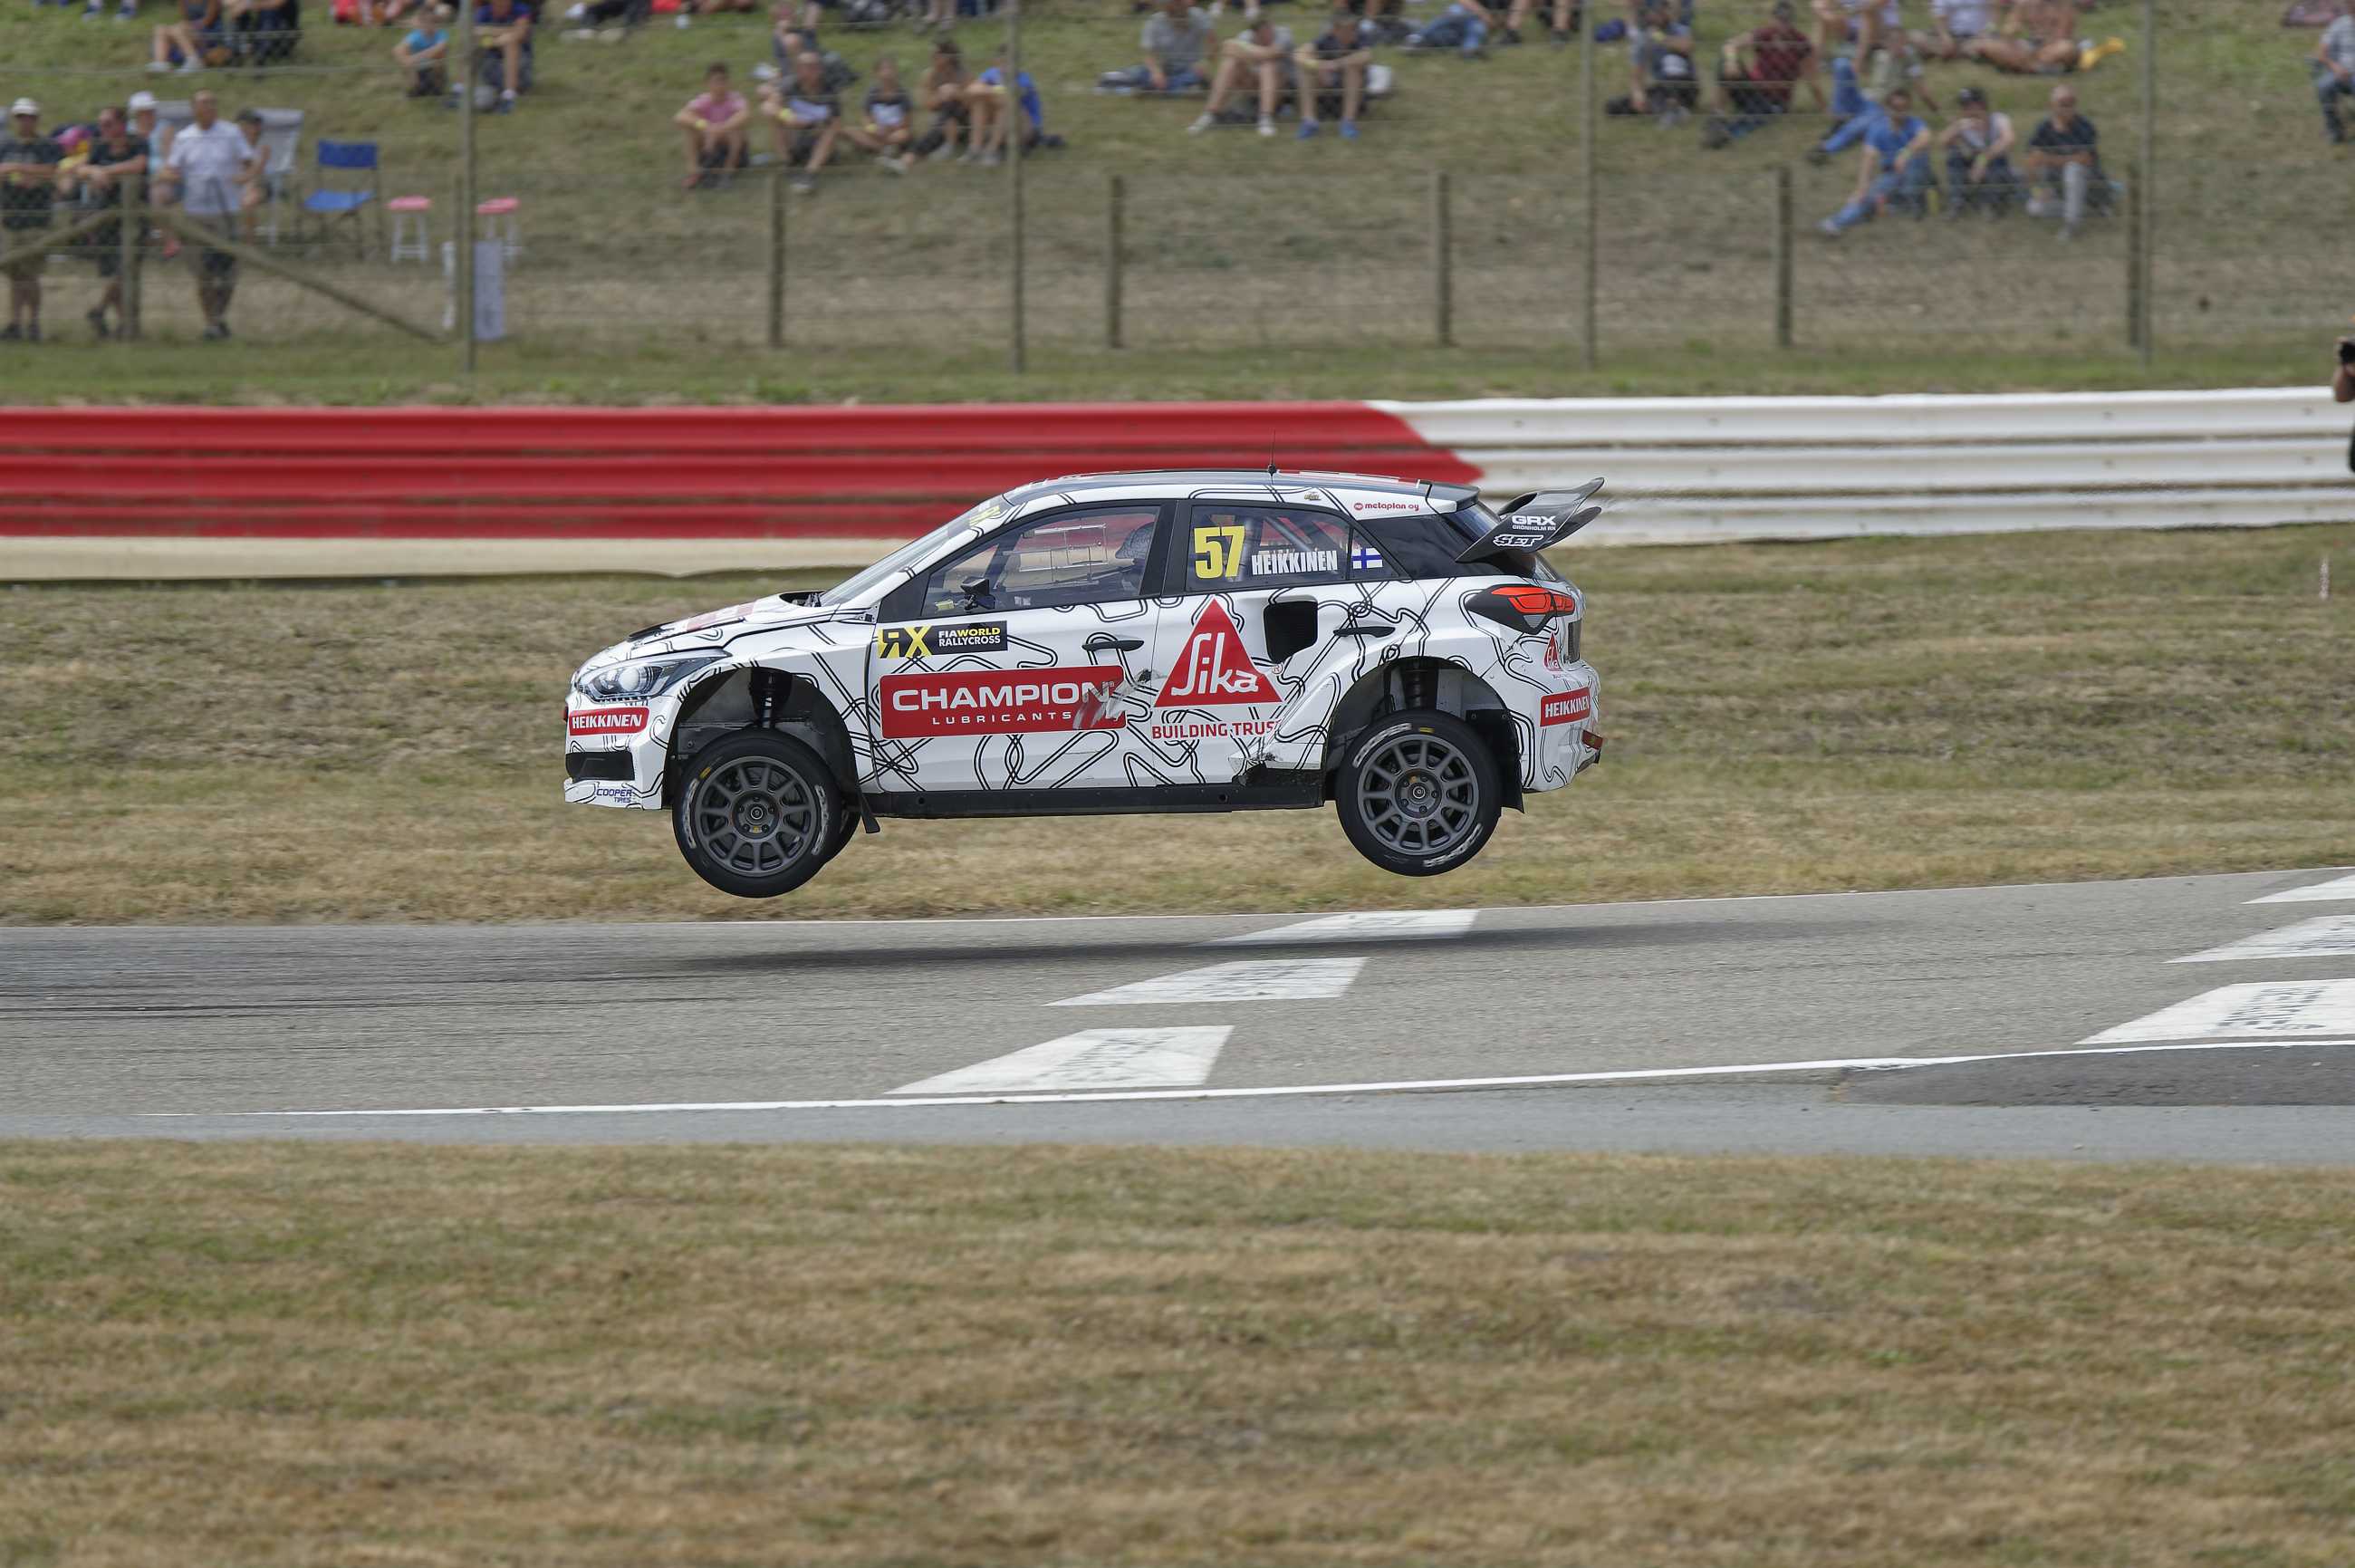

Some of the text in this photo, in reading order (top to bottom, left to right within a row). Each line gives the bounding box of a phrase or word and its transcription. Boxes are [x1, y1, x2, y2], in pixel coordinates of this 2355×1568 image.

[1512, 515, 1557, 525] GRX
[1194, 525, 1245, 579] 57
[1251, 550, 1338, 575] HEIKKINEN
[938, 634, 1001, 647] RALLYCROSS
[1171, 632, 1259, 696] Sika
[892, 681, 1110, 711] CHAMPION
[572, 714, 642, 729] HEIKKINEN
[932, 711, 1072, 726] LUBRICANTS
[1152, 724, 1228, 740] BUILDING
[596, 788, 632, 797] COOPER
